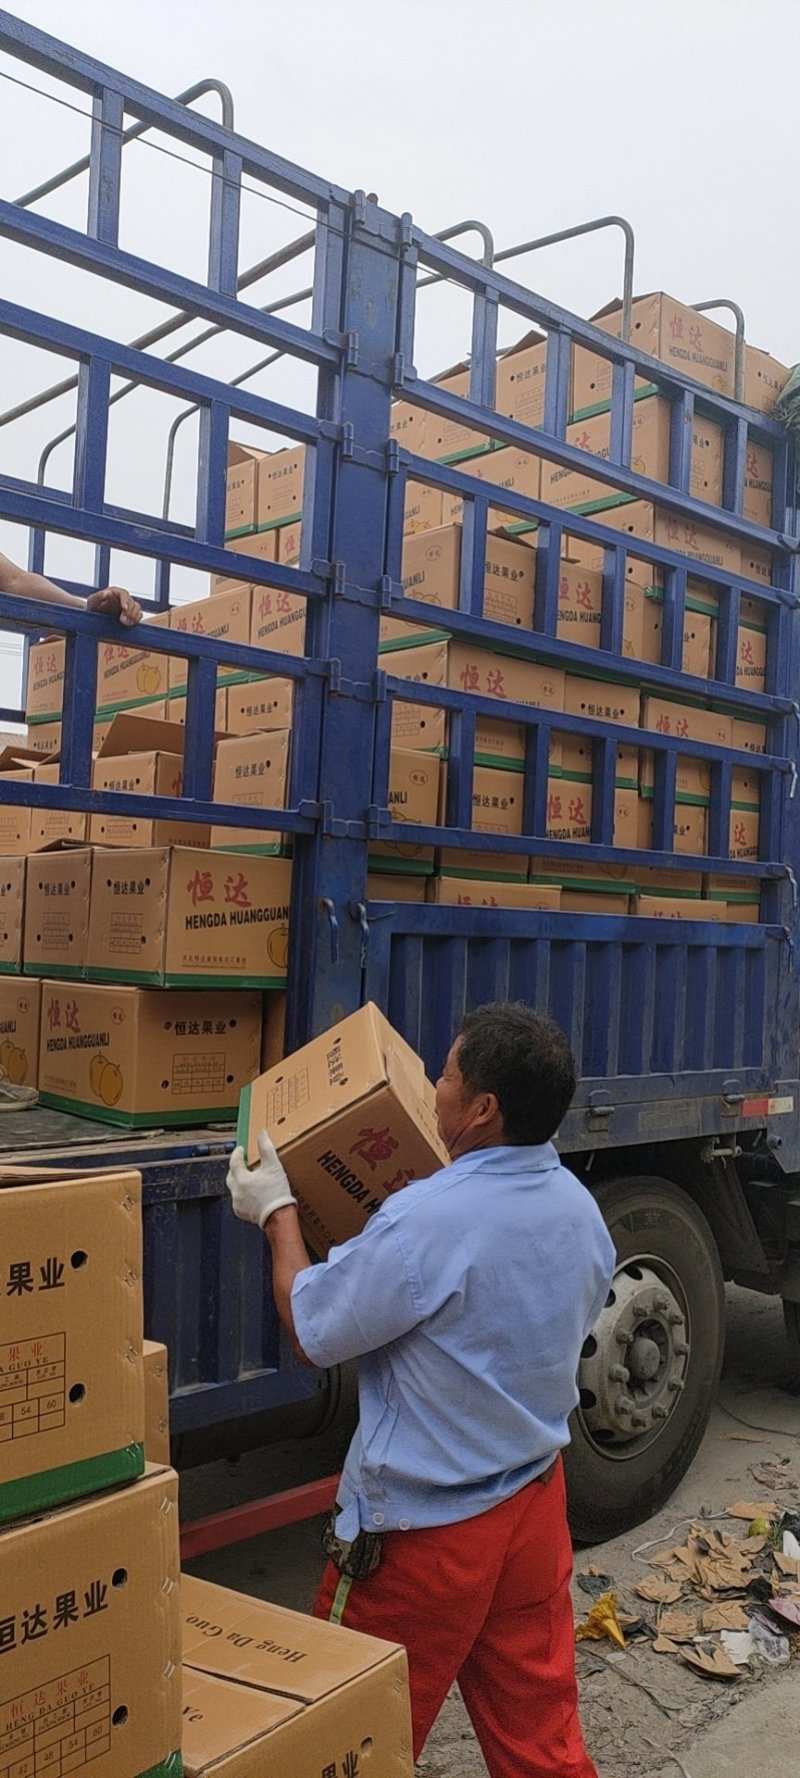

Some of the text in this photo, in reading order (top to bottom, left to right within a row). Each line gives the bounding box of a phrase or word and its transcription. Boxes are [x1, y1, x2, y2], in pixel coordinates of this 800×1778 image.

[259, 591, 293, 624] 恒达
[460, 663, 507, 699] 恒达
[113, 879, 145, 896] 恒达果业
[186, 870, 252, 907] 恒达
[185, 912, 228, 931] HENGDA
[48, 997, 81, 1034] 恒达
[174, 1020, 227, 1036] 恒达果业
[316, 1150, 370, 1203] HENGDA
[20, 1405, 31, 1416] 54
[46, 1399, 57, 1410] 60
[186, 1614, 309, 1664] Heng Da Guo
[69, 1738, 79, 1749] 54
